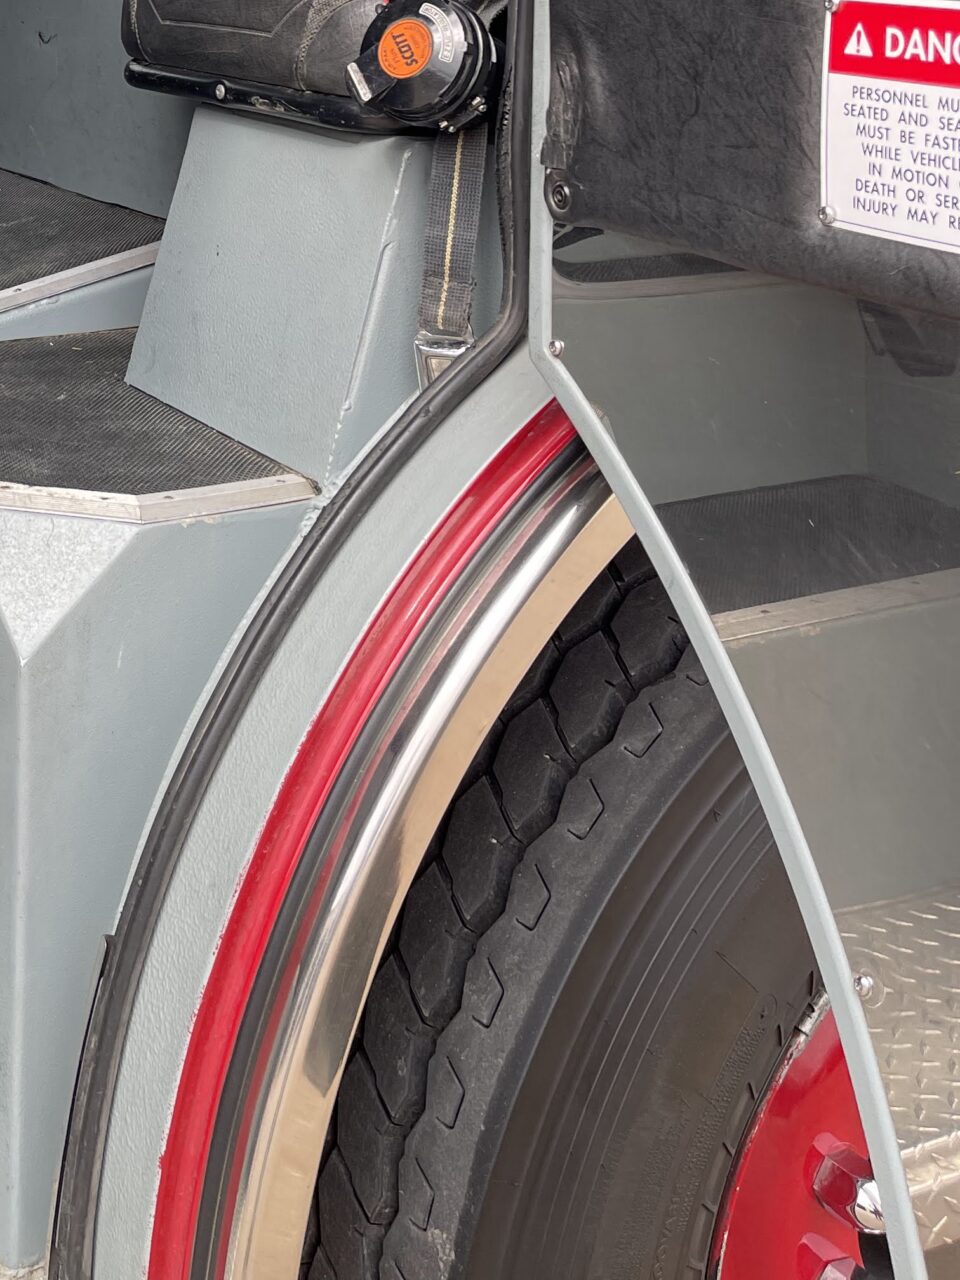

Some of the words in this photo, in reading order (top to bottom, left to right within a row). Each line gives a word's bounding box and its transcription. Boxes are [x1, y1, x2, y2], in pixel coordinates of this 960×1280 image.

[391, 32, 419, 67] SCOTT
[852, 85, 929, 109] PERSONNEL
[843, 102, 889, 122] SEATED
[898, 110, 929, 128] AND
[856, 123, 891, 141] MUST
[900, 130, 916, 145] BE
[861, 142, 901, 162] WHILE
[868, 162, 882, 177] IN
[891, 166, 950, 189] MOTION
[855, 178, 897, 198] DEATH
[905, 188, 925, 205] OR
[852, 196, 898, 218] INJURY
[906, 207, 939, 226] MAY
